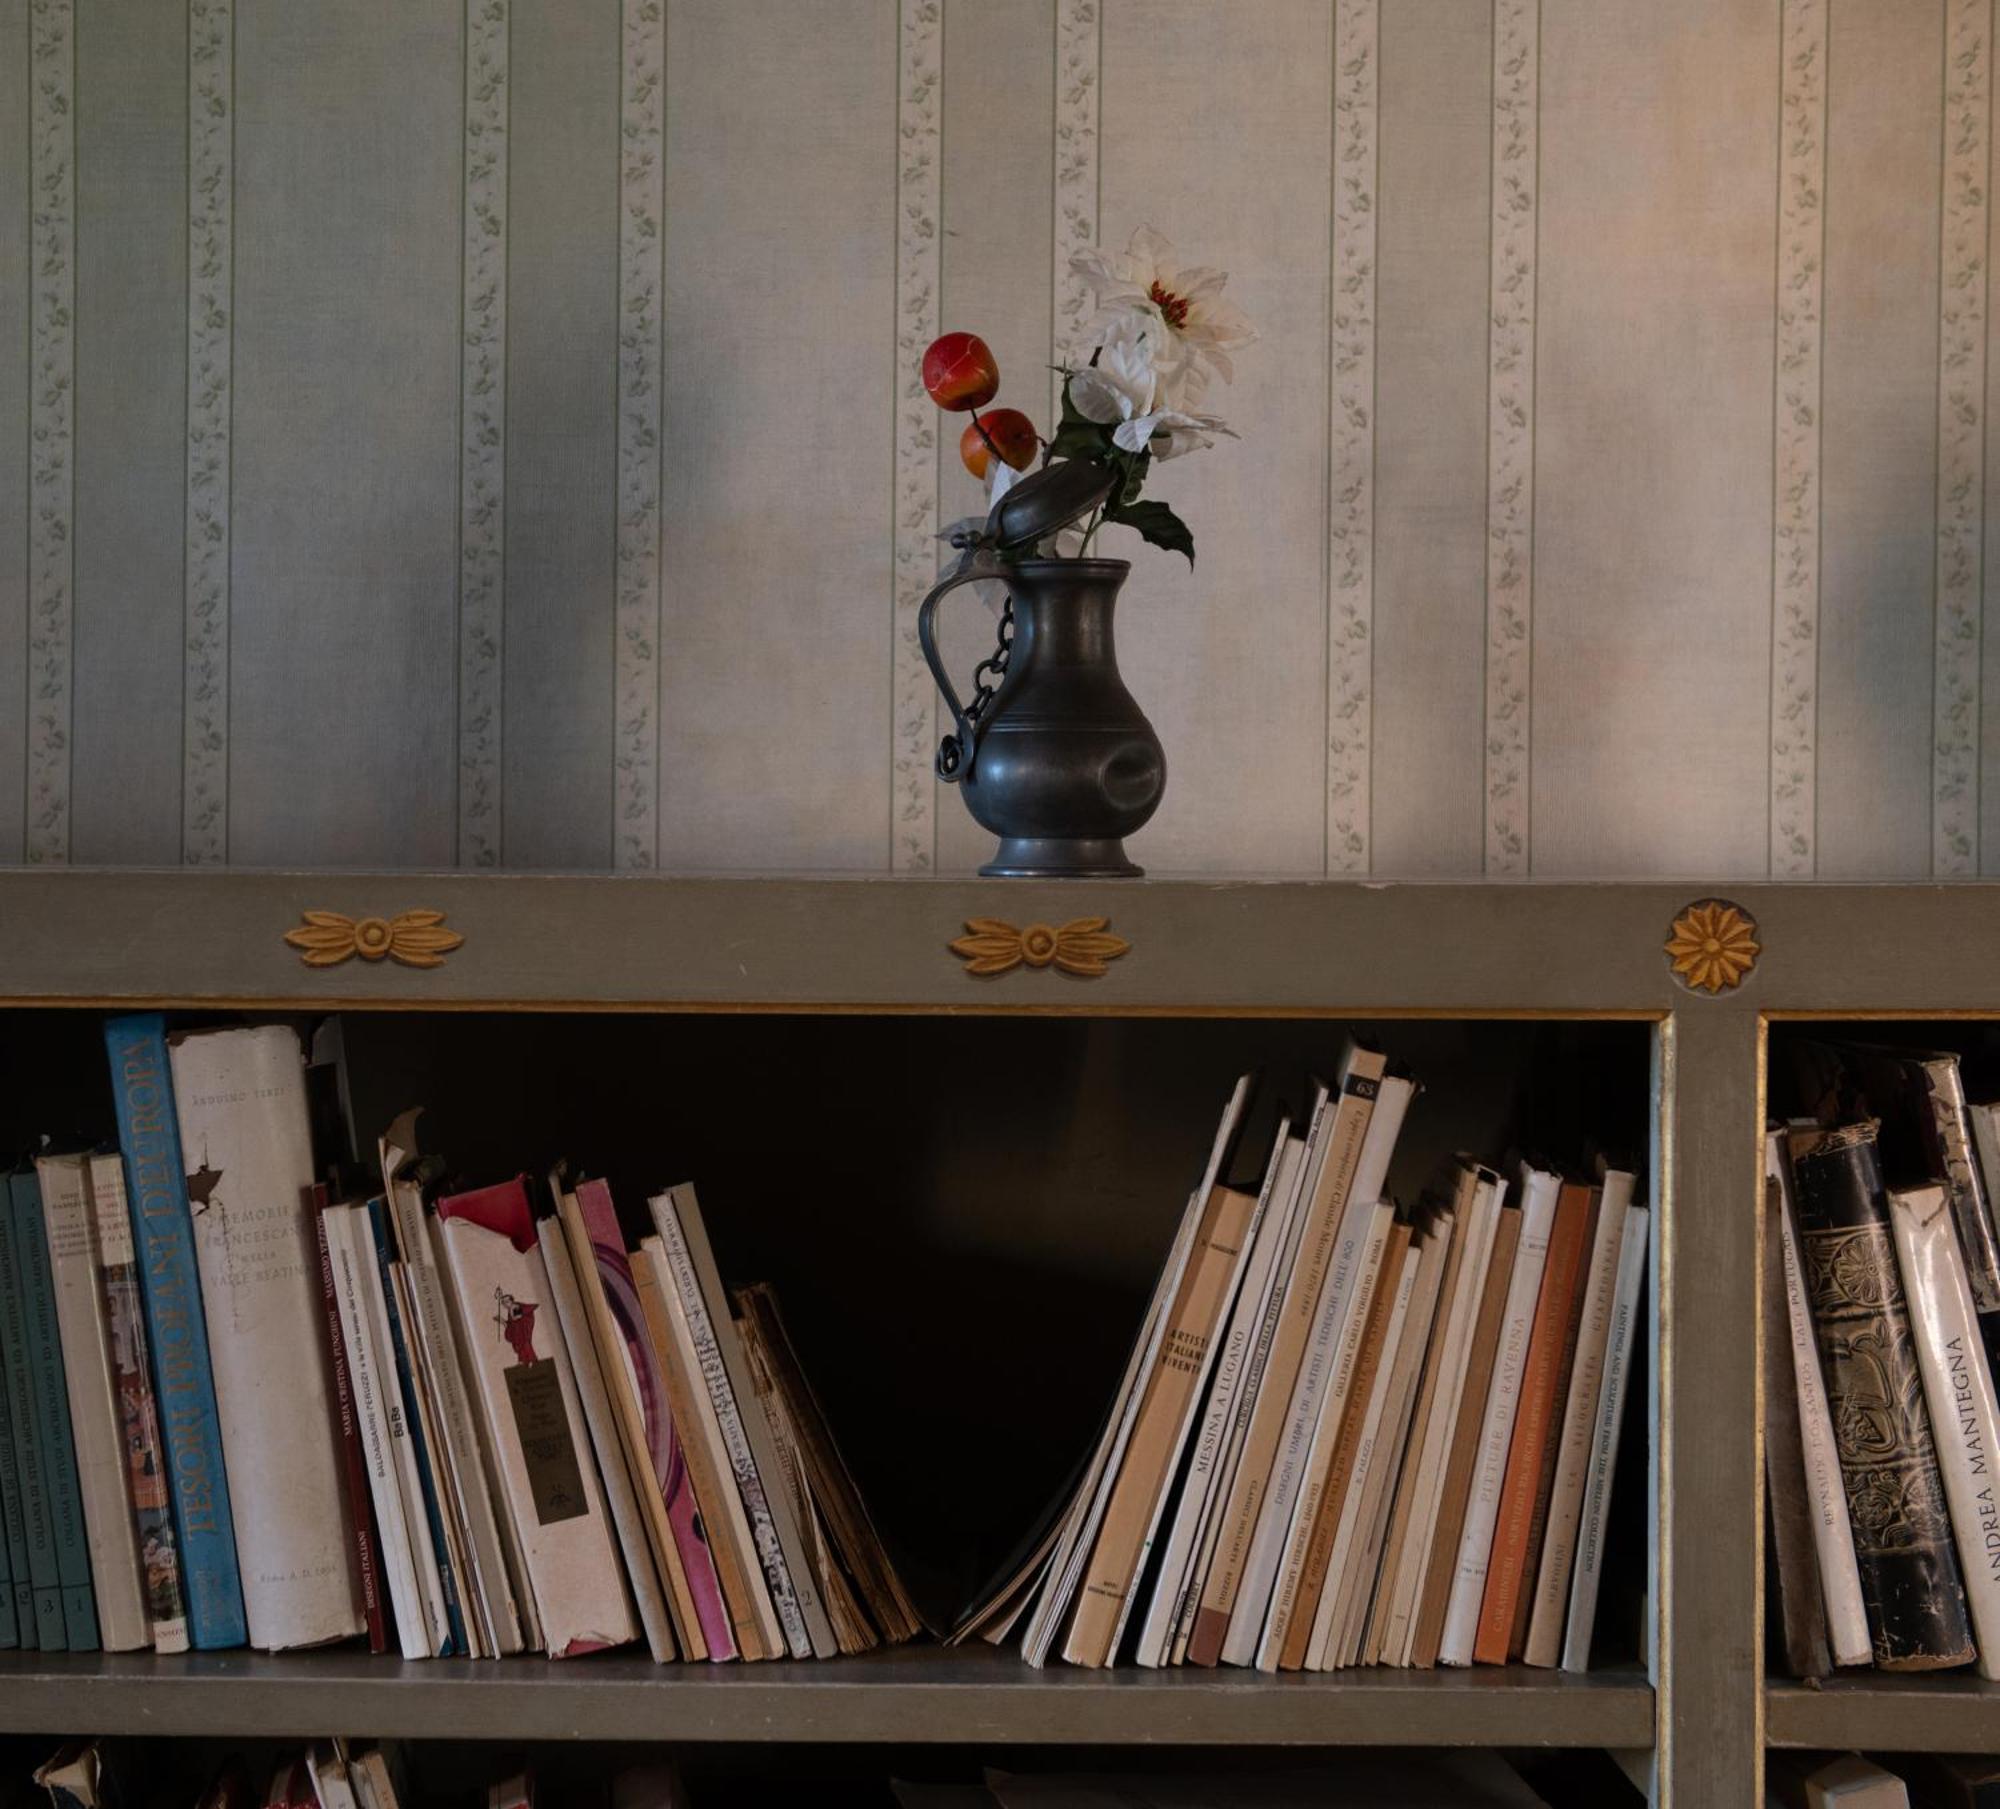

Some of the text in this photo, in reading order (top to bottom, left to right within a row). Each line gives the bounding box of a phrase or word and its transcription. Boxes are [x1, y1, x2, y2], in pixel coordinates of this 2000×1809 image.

[1355, 1081, 1374, 1096] 63
[1322, 1190, 1341, 1229] Claude
[321, 1255, 334, 1298] MASSIMO
[146, 1233, 196, 1394] PROFANI
[1334, 1351, 1354, 1398] GALLERIA
[1347, 1318, 1362, 1350] CARLO
[1355, 1272, 1374, 1316] VIRGILIO
[1369, 1237, 1383, 1265] ROMA
[1165, 1341, 1205, 1361] ITALIANI
[1170, 1329, 1209, 1348] ARTISTI
[334, 1358, 348, 1401] CRISTINA
[1162, 1355, 1201, 1375] VIVENTI
[1610, 1355, 1621, 1375] AND
[359, 1370, 374, 1410] PERUZZI
[1196, 1329, 1244, 1474] MESSINA A LUGANO
[1273, 1459, 1294, 1505] DISEGNI
[1304, 1352, 1323, 1393] ARTISTI
[1316, 1294, 1339, 1347] TEDESCHI
[1479, 1315, 1525, 1502] PITTURE DI RAVENNA
[1944, 1336, 1988, 1476] MANTEGNA
[340, 1402, 352, 1435] MARIA
[366, 1412, 385, 1477] BALDASSARRE
[1599, 1430, 1611, 1454] FROM
[1800, 1361, 1833, 1526] REYNALDO DOS SANTOS
[169, 1406, 215, 1538] TESORI
[1596, 1456, 1608, 1476] THE
[357, 1529, 370, 1571] ITALIANI
[1492, 1556, 1514, 1632] CARABINIERI
[1507, 1490, 1526, 1545] SERVIZIO
[1584, 1516, 1600, 1572] COLLECTION
